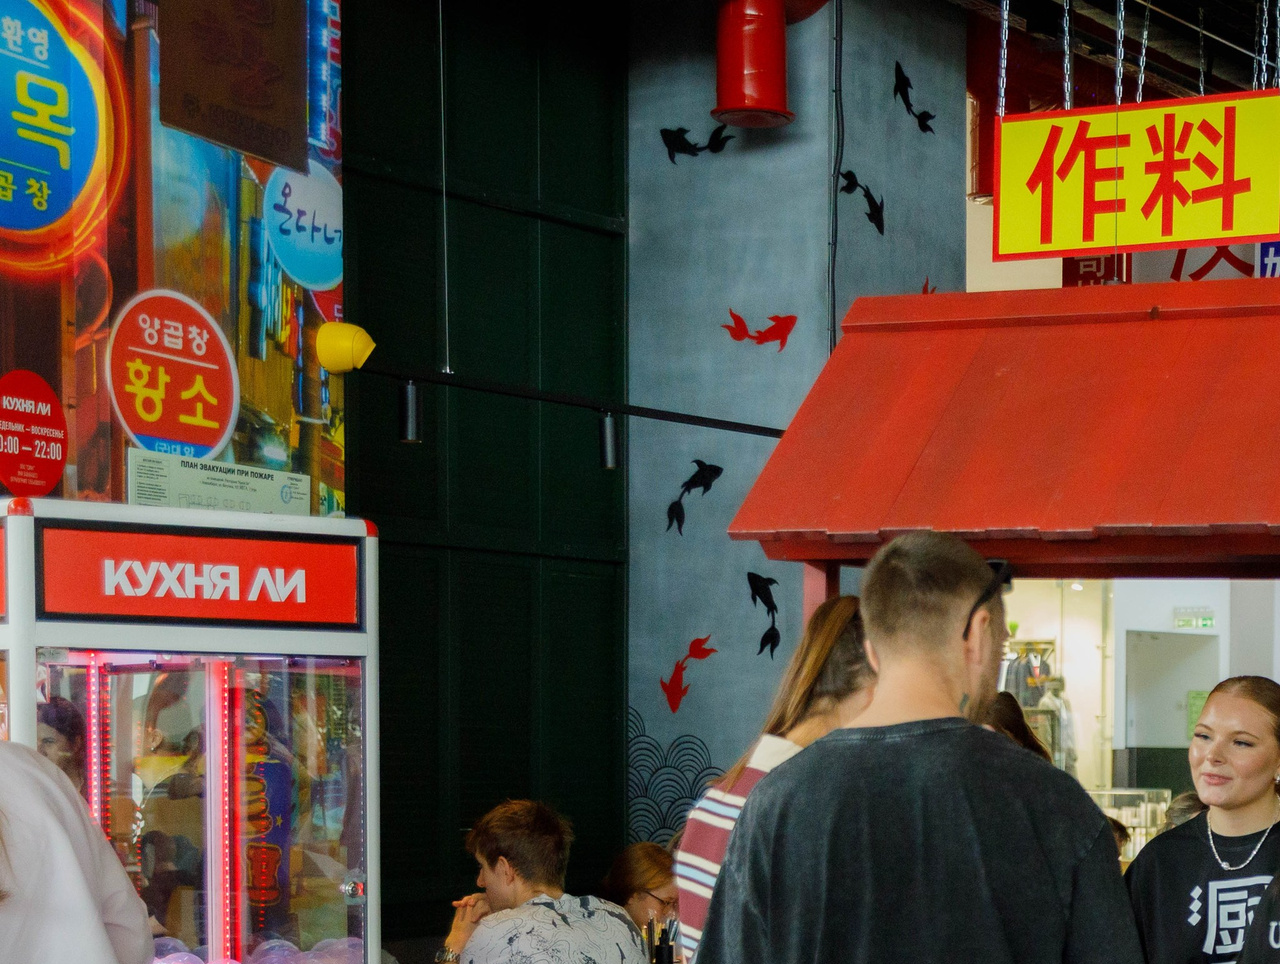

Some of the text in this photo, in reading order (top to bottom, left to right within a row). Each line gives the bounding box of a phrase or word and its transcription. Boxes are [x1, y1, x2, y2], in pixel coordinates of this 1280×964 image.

[1026, 106, 1251, 245] 作料
[138, 313, 210, 356] 양곱창
[3, 395, 51, 416] КУХНЯ ЛИ
[125, 358, 220, 430] 황소
[31, 425, 65, 439] ВОСКРЕСЕНЬЕ
[34, 440, 62, 460] 22:00
[181, 460, 275, 481] ПЛАН ЭВАКУАЦИИ ПРИ ПОЖАРЕ
[104, 558, 306, 603] КУХНЯ ЛИ
